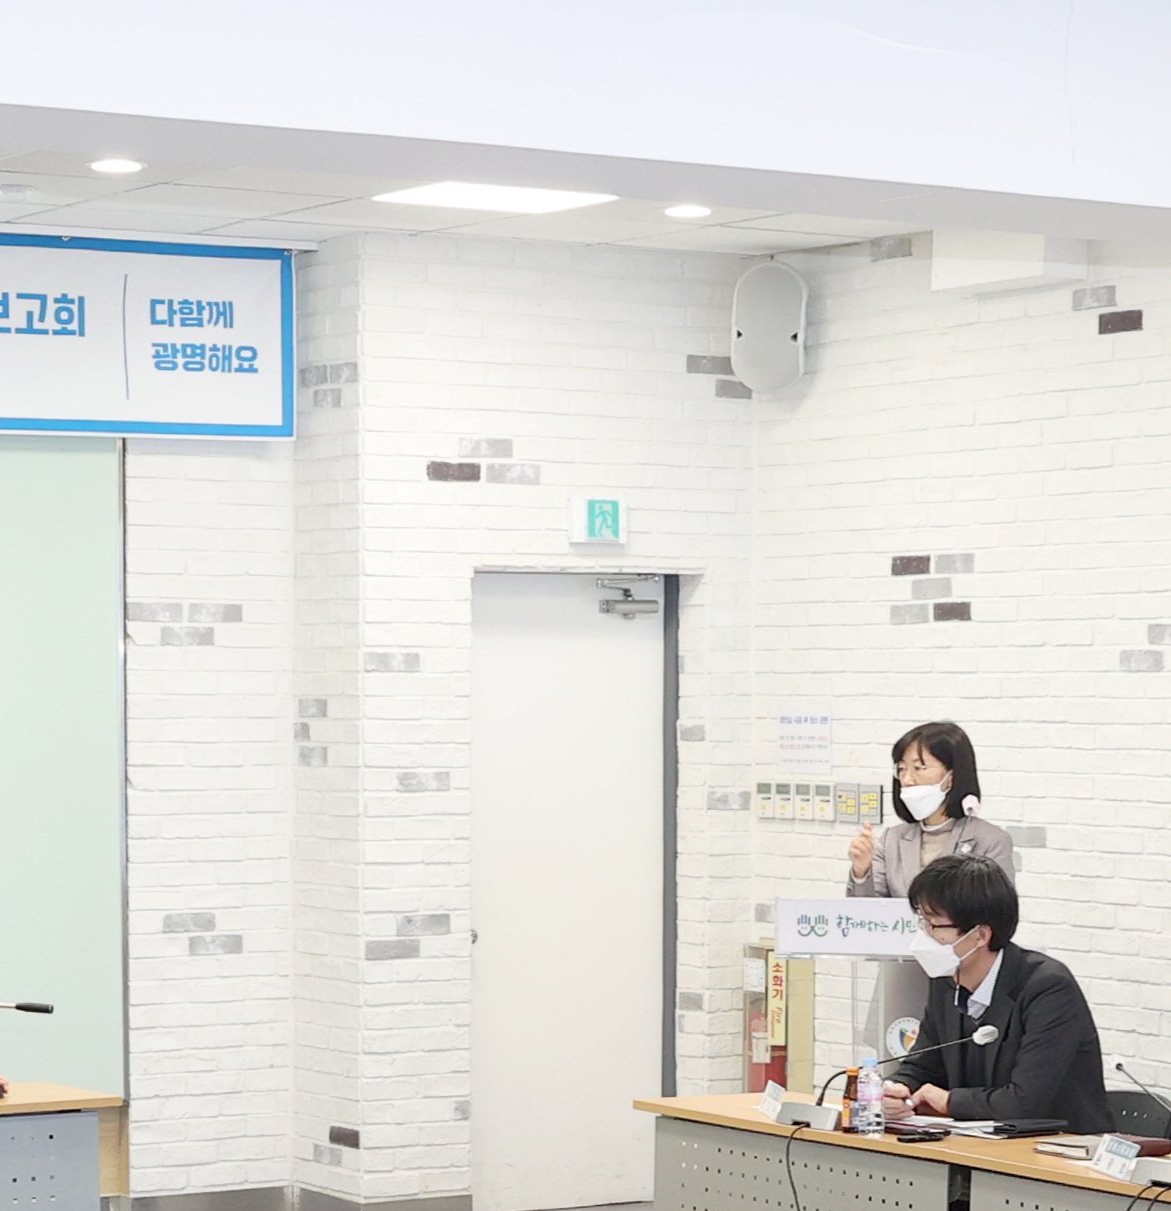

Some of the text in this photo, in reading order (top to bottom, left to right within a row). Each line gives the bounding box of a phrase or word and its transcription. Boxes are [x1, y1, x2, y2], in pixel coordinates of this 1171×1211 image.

[148, 296, 235, 330] 다함께
[150, 340, 260, 375] 광명해요
[835, 913, 890, 938] 함께하는
[772, 961, 784, 1001] 소화기
